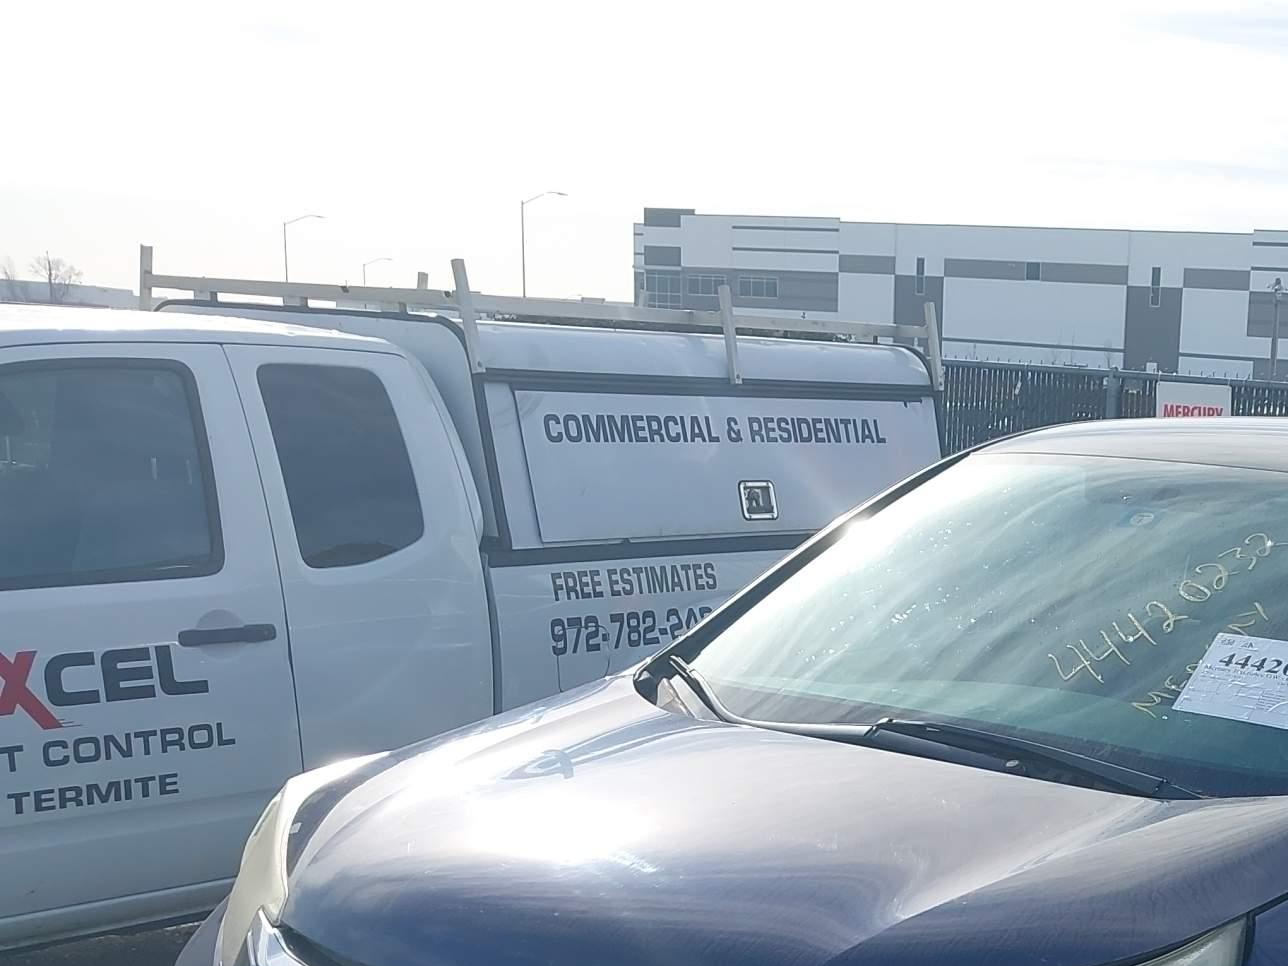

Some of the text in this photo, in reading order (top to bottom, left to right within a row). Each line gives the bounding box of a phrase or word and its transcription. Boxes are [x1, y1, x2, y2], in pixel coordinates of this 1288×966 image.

[543, 413, 888, 445] COMMERCIAL & RESIDENTIAL
[551, 562, 718, 602] FREE ESTIMATES
[42, 722, 237, 768] CONTROL
[7, 772, 180, 816] TERMITE
